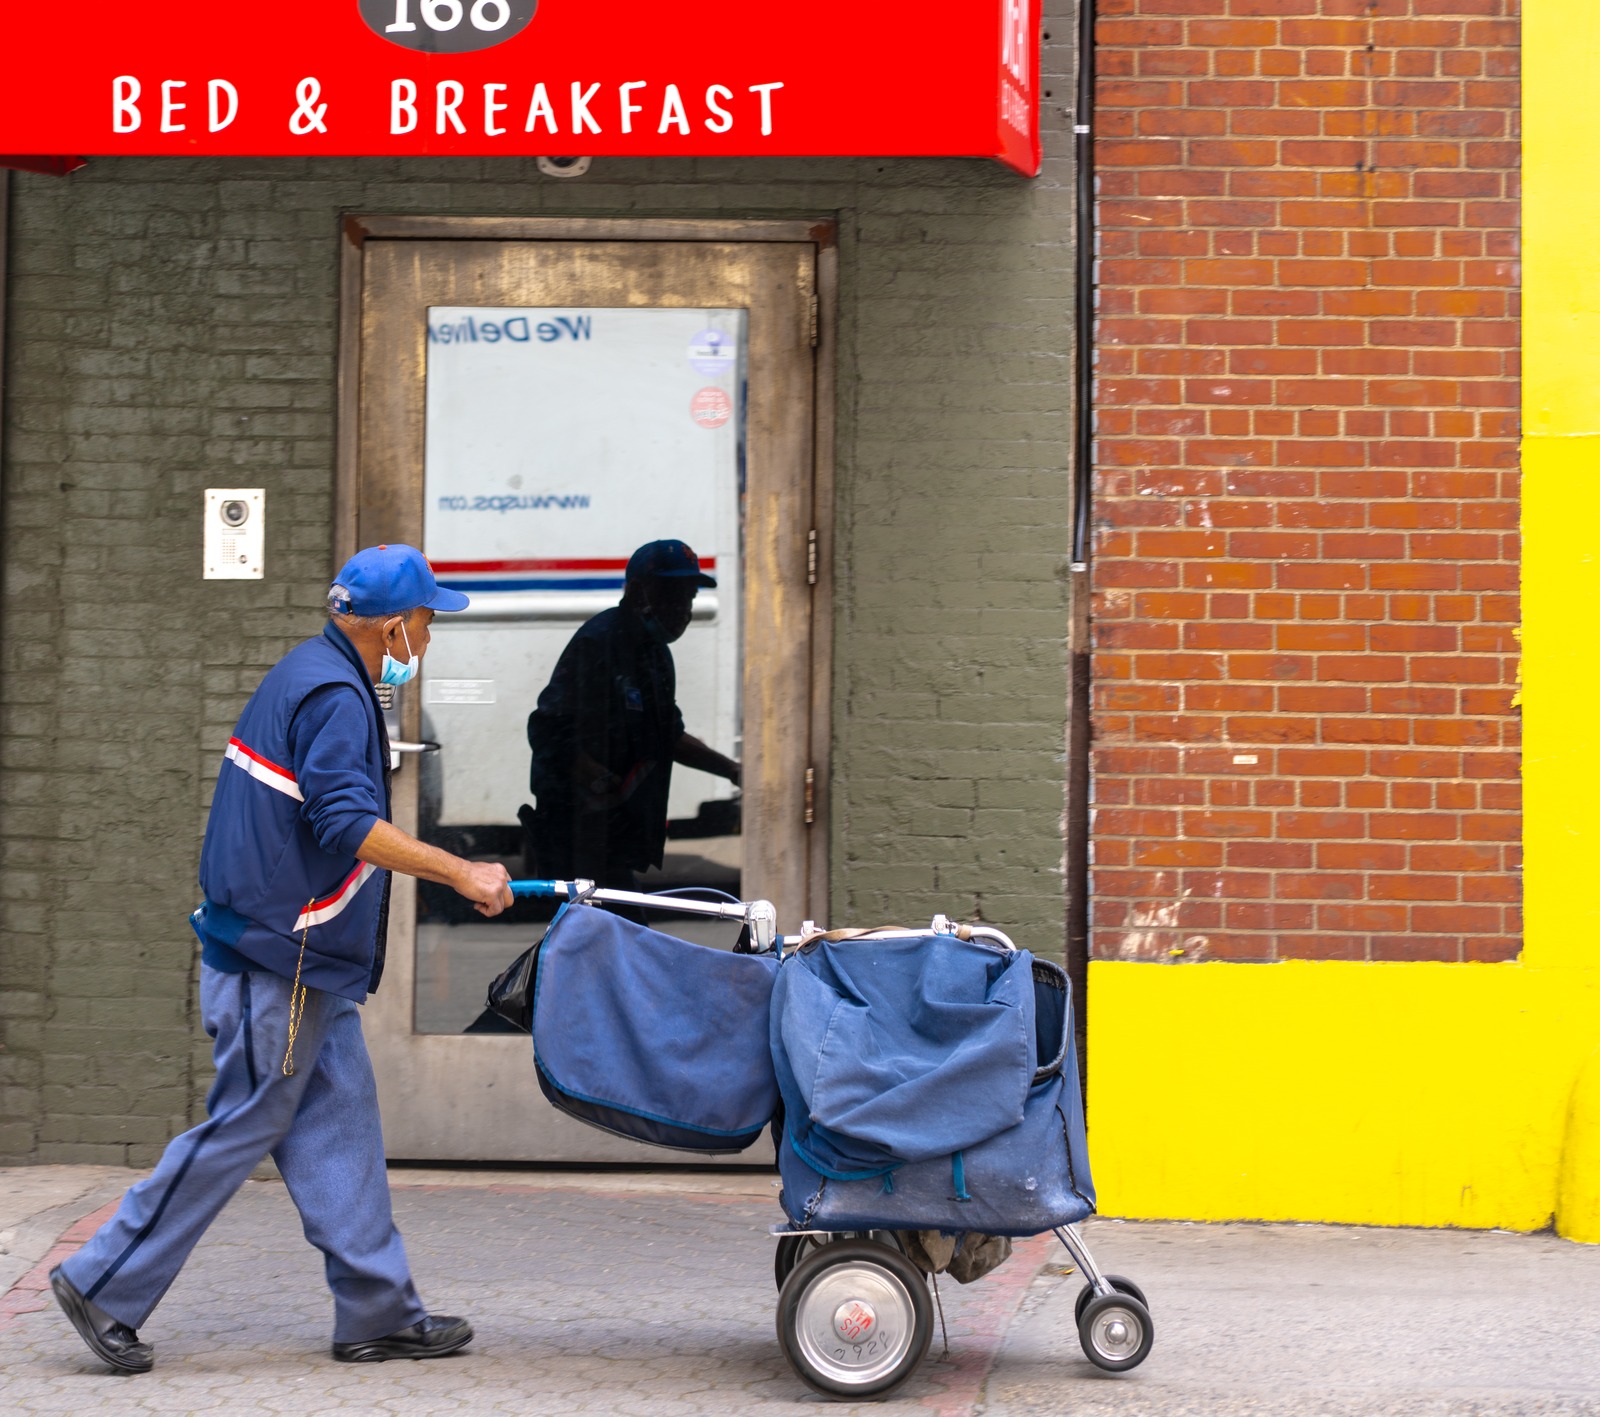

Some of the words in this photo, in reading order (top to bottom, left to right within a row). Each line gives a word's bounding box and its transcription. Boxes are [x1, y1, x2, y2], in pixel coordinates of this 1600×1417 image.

[112, 75, 239, 134] BED
[288, 76, 328, 135] &
[389, 78, 785, 137] BREAKFAST
